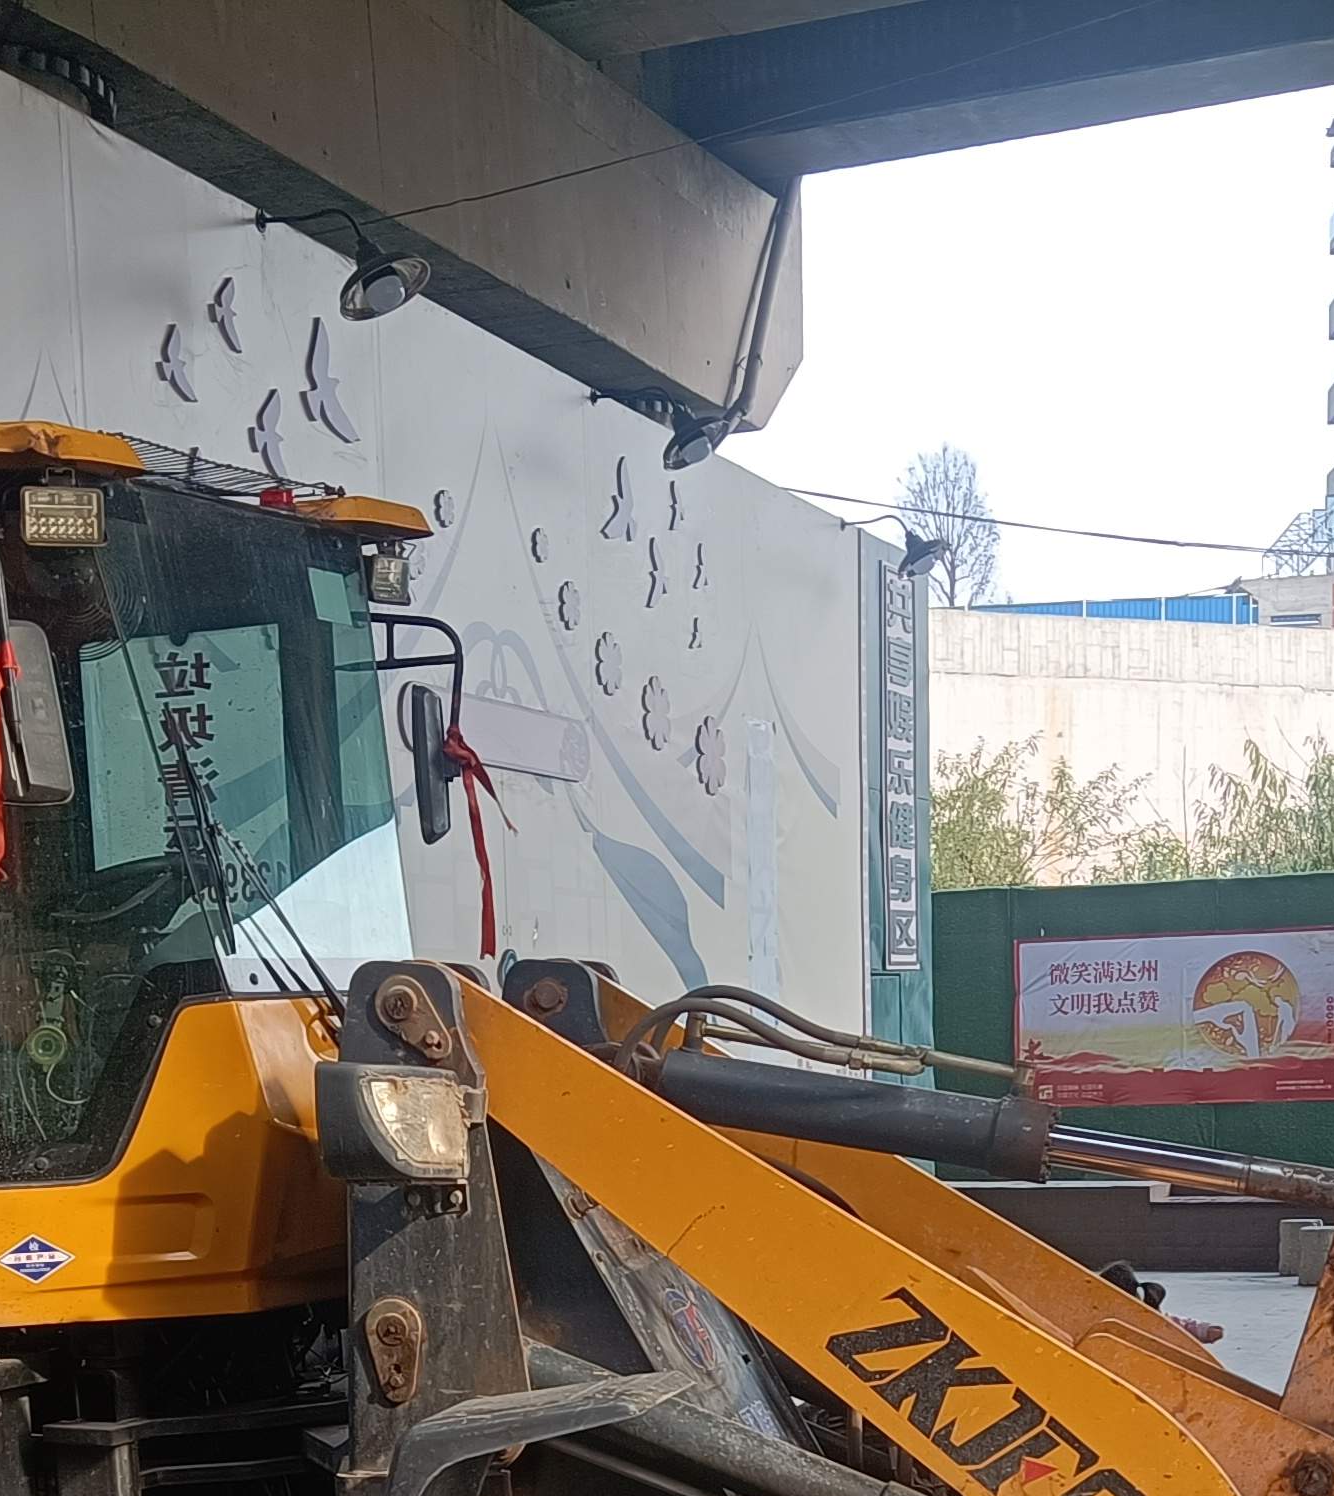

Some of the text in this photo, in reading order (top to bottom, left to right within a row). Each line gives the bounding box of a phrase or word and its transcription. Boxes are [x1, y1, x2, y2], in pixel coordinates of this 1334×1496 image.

[886, 578, 917, 954] 共享娱乐健身区
[1050, 960, 1158, 985] 微笑满达州
[1049, 990, 1160, 1016] 文明我点赞
